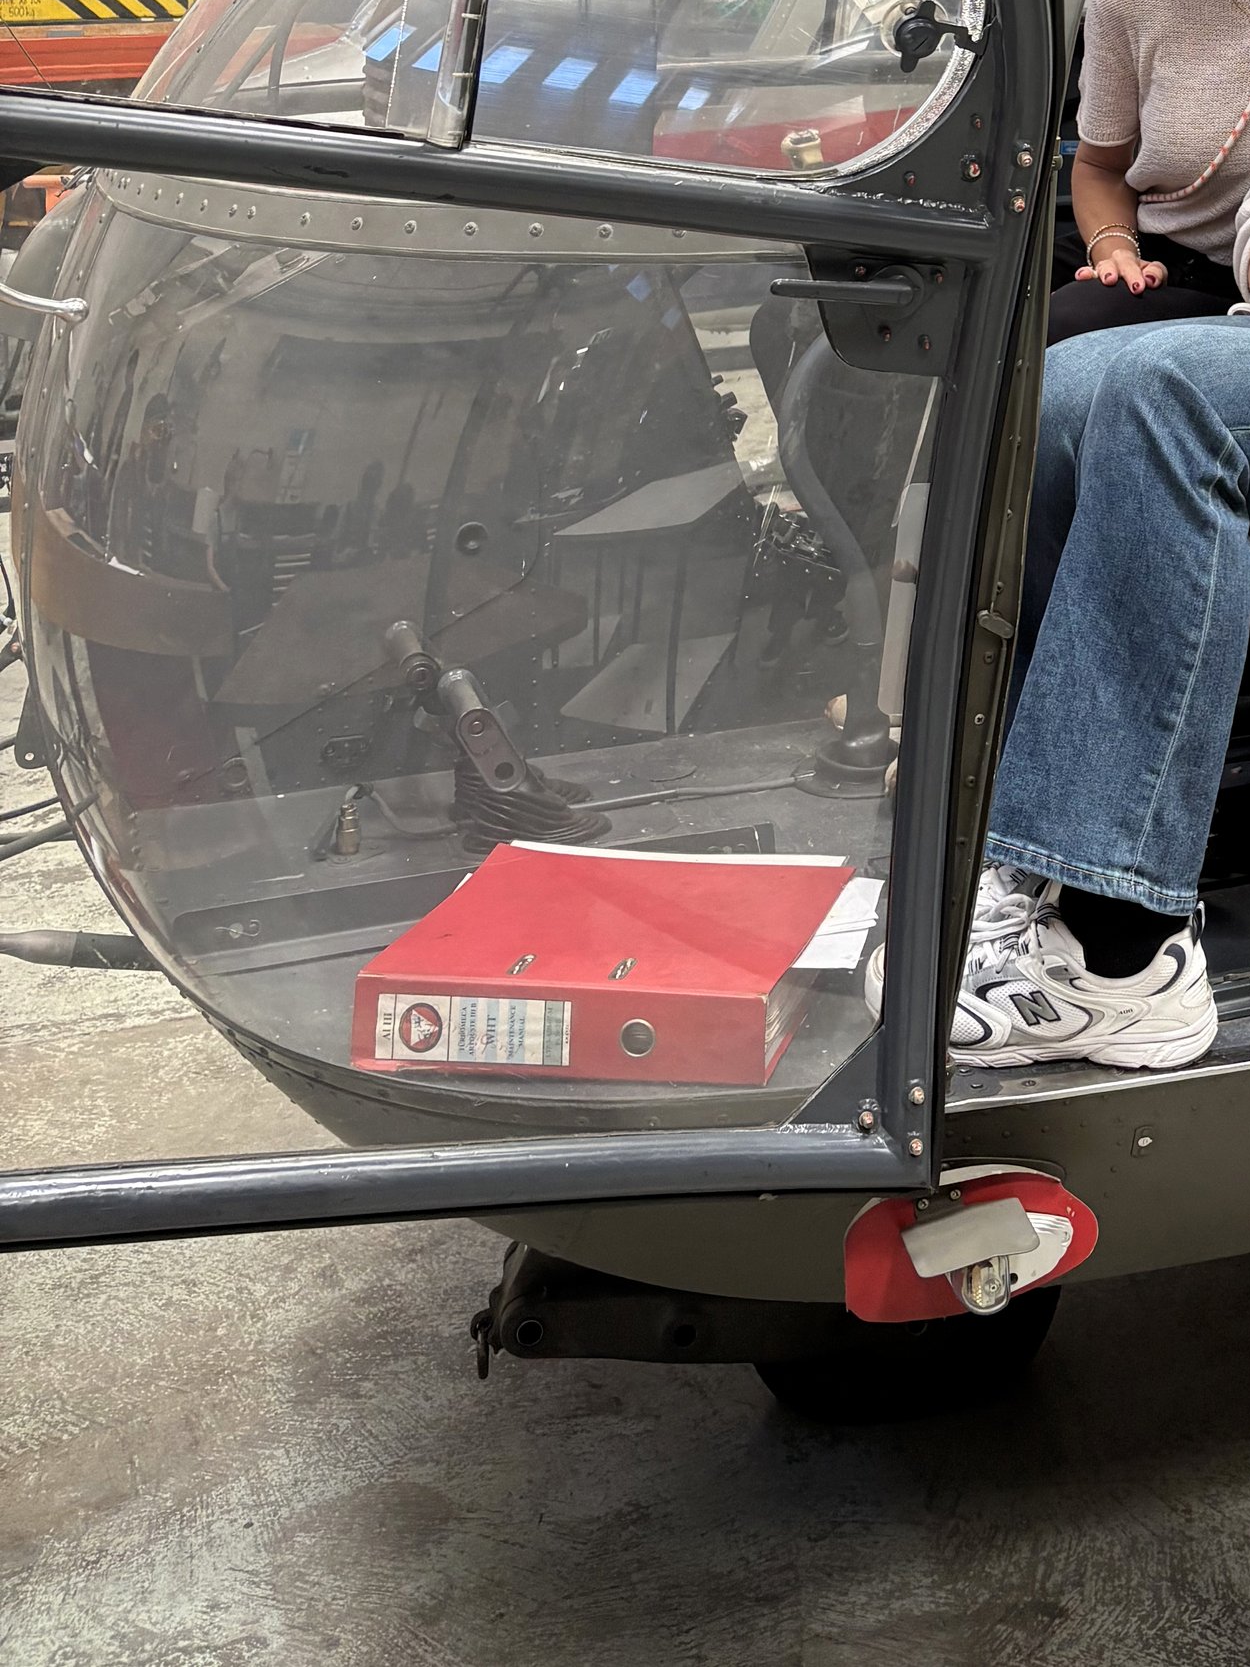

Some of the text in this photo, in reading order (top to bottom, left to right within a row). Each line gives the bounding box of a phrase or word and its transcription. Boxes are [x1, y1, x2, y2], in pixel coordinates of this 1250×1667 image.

[1009, 990, 1061, 1026] N
[507, 1005, 517, 1058] MAINTENANCE
[518, 1016, 526, 1048] MANUAL
